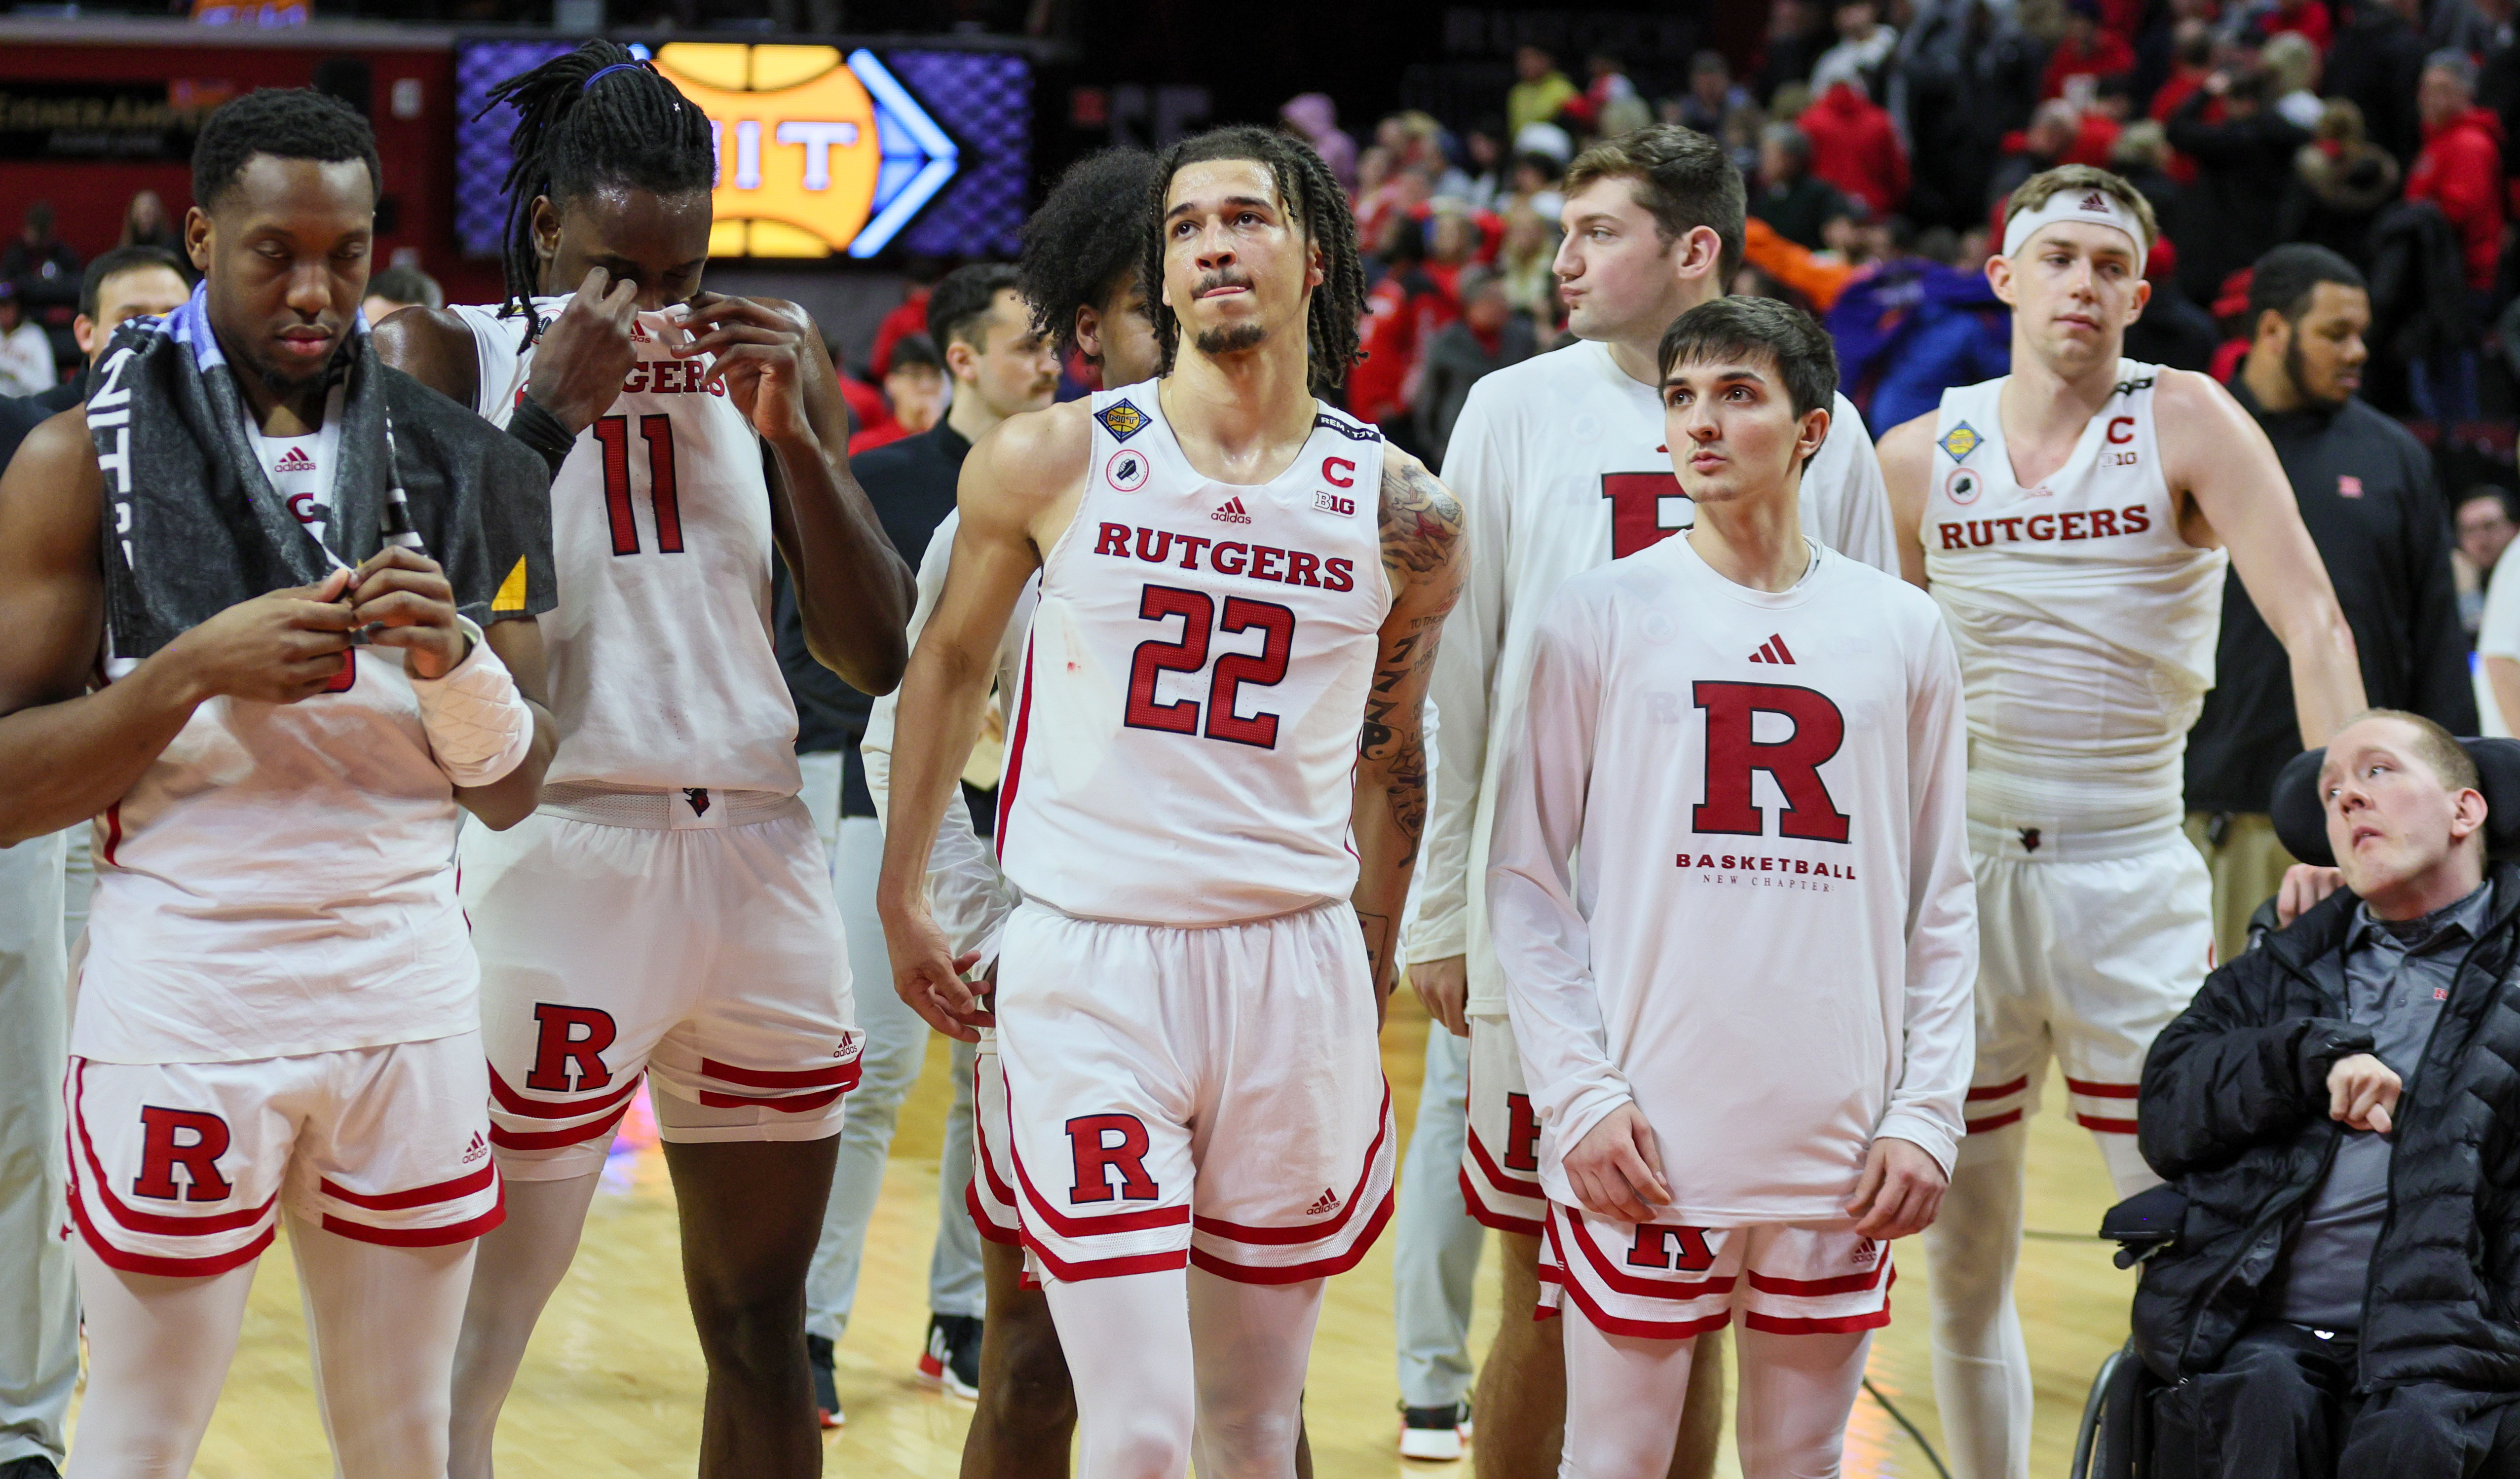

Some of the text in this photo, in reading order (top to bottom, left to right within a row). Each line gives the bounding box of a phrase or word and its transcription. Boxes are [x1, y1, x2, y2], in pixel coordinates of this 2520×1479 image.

[631, 333, 651, 344] das
[1109, 414, 1138, 424] NIT
[1321, 416, 1345, 432] REM
[2107, 416, 2135, 444] C
[274, 461, 316, 473] adidas
[1322, 456, 1355, 488] C
[593, 413, 684, 556] 11
[1210, 512, 1251, 524] adidas
[1938, 504, 2150, 550] RUTGERS
[1093, 522, 1354, 592] RUTGERS
[1124, 583, 1296, 750] 22
[1692, 680, 1851, 844] R
[1676, 853, 1856, 880] BASKETBALL
[1702, 874, 1830, 892] NEW CHAPTER
[526, 1002, 617, 1092] R
[833, 1044, 858, 1058] adidas
[133, 1105, 233, 1202] R
[1065, 1113, 1159, 1204] R
[1306, 1200, 1341, 1215] adidas
